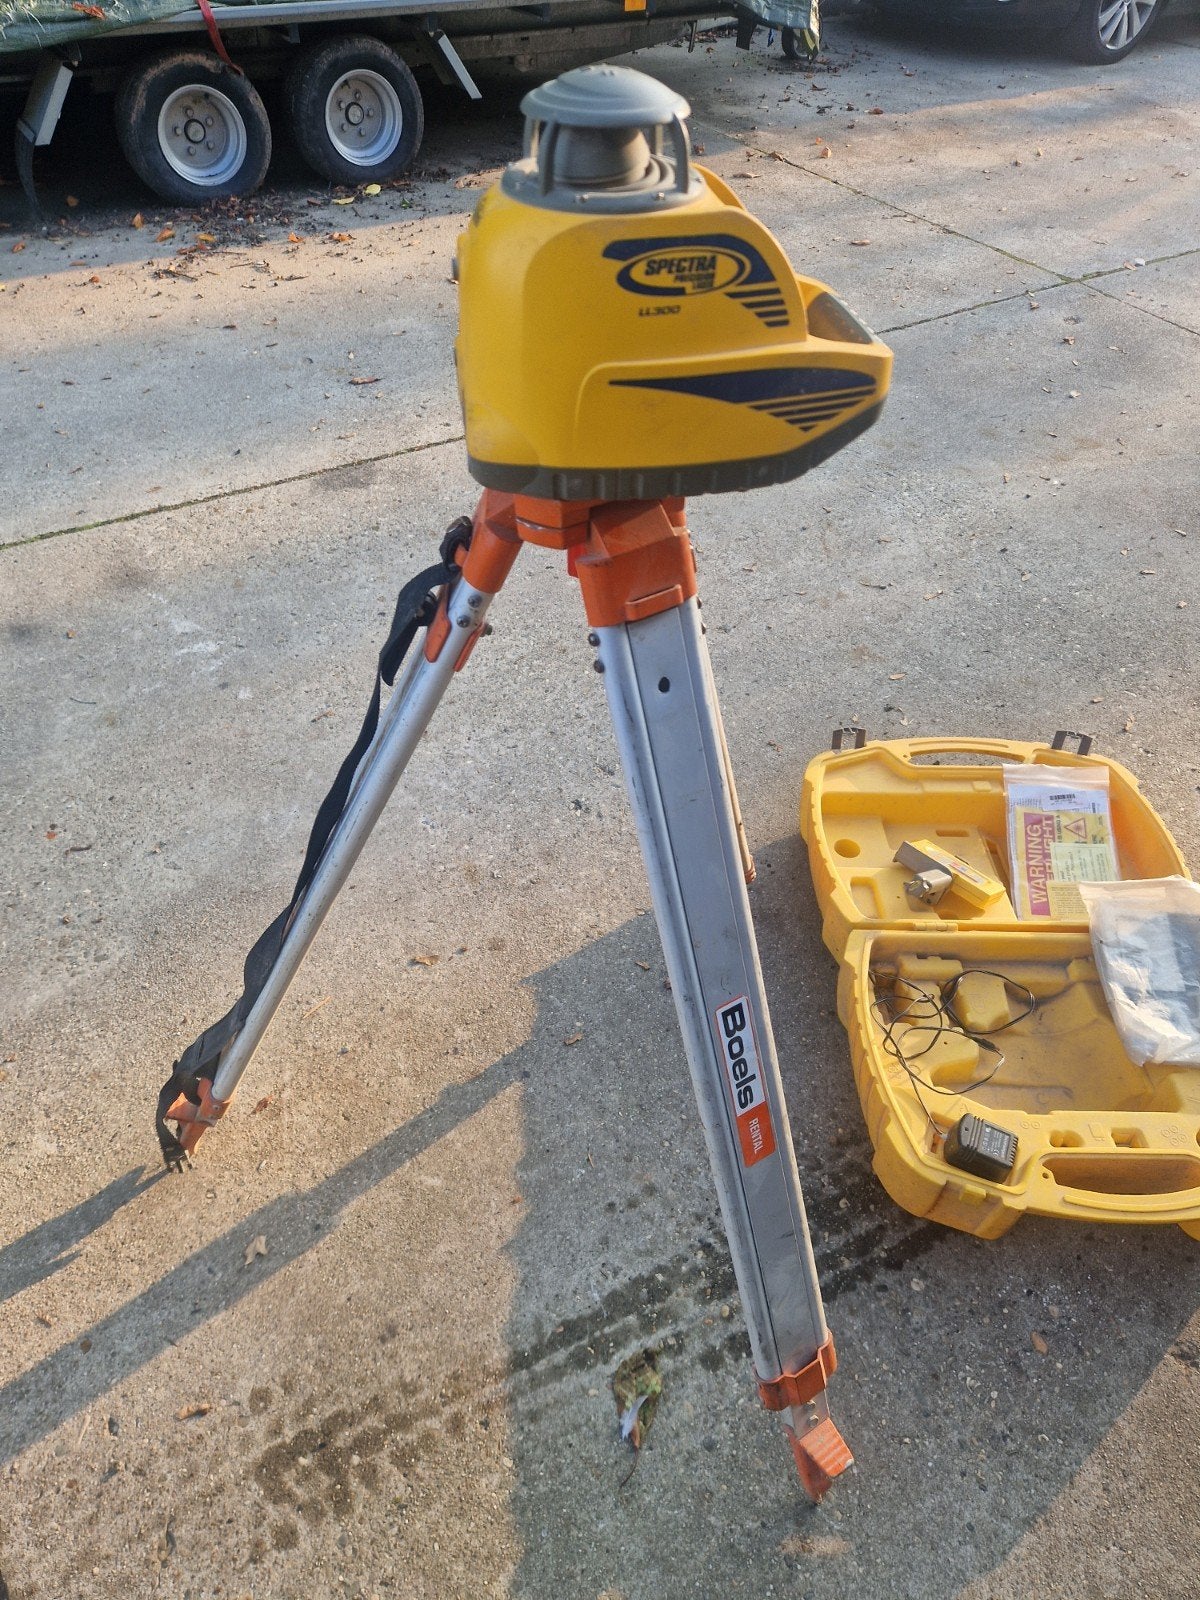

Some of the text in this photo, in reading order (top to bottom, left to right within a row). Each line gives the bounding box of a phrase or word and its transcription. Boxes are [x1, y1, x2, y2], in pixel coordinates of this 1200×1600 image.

[645, 255, 717, 275] SPECTRA
[638, 305, 681, 317] LL300
[1027, 824, 1047, 903] WARNING
[721, 1002, 756, 1110] Boels
[749, 1117, 763, 1154] RENTAL
